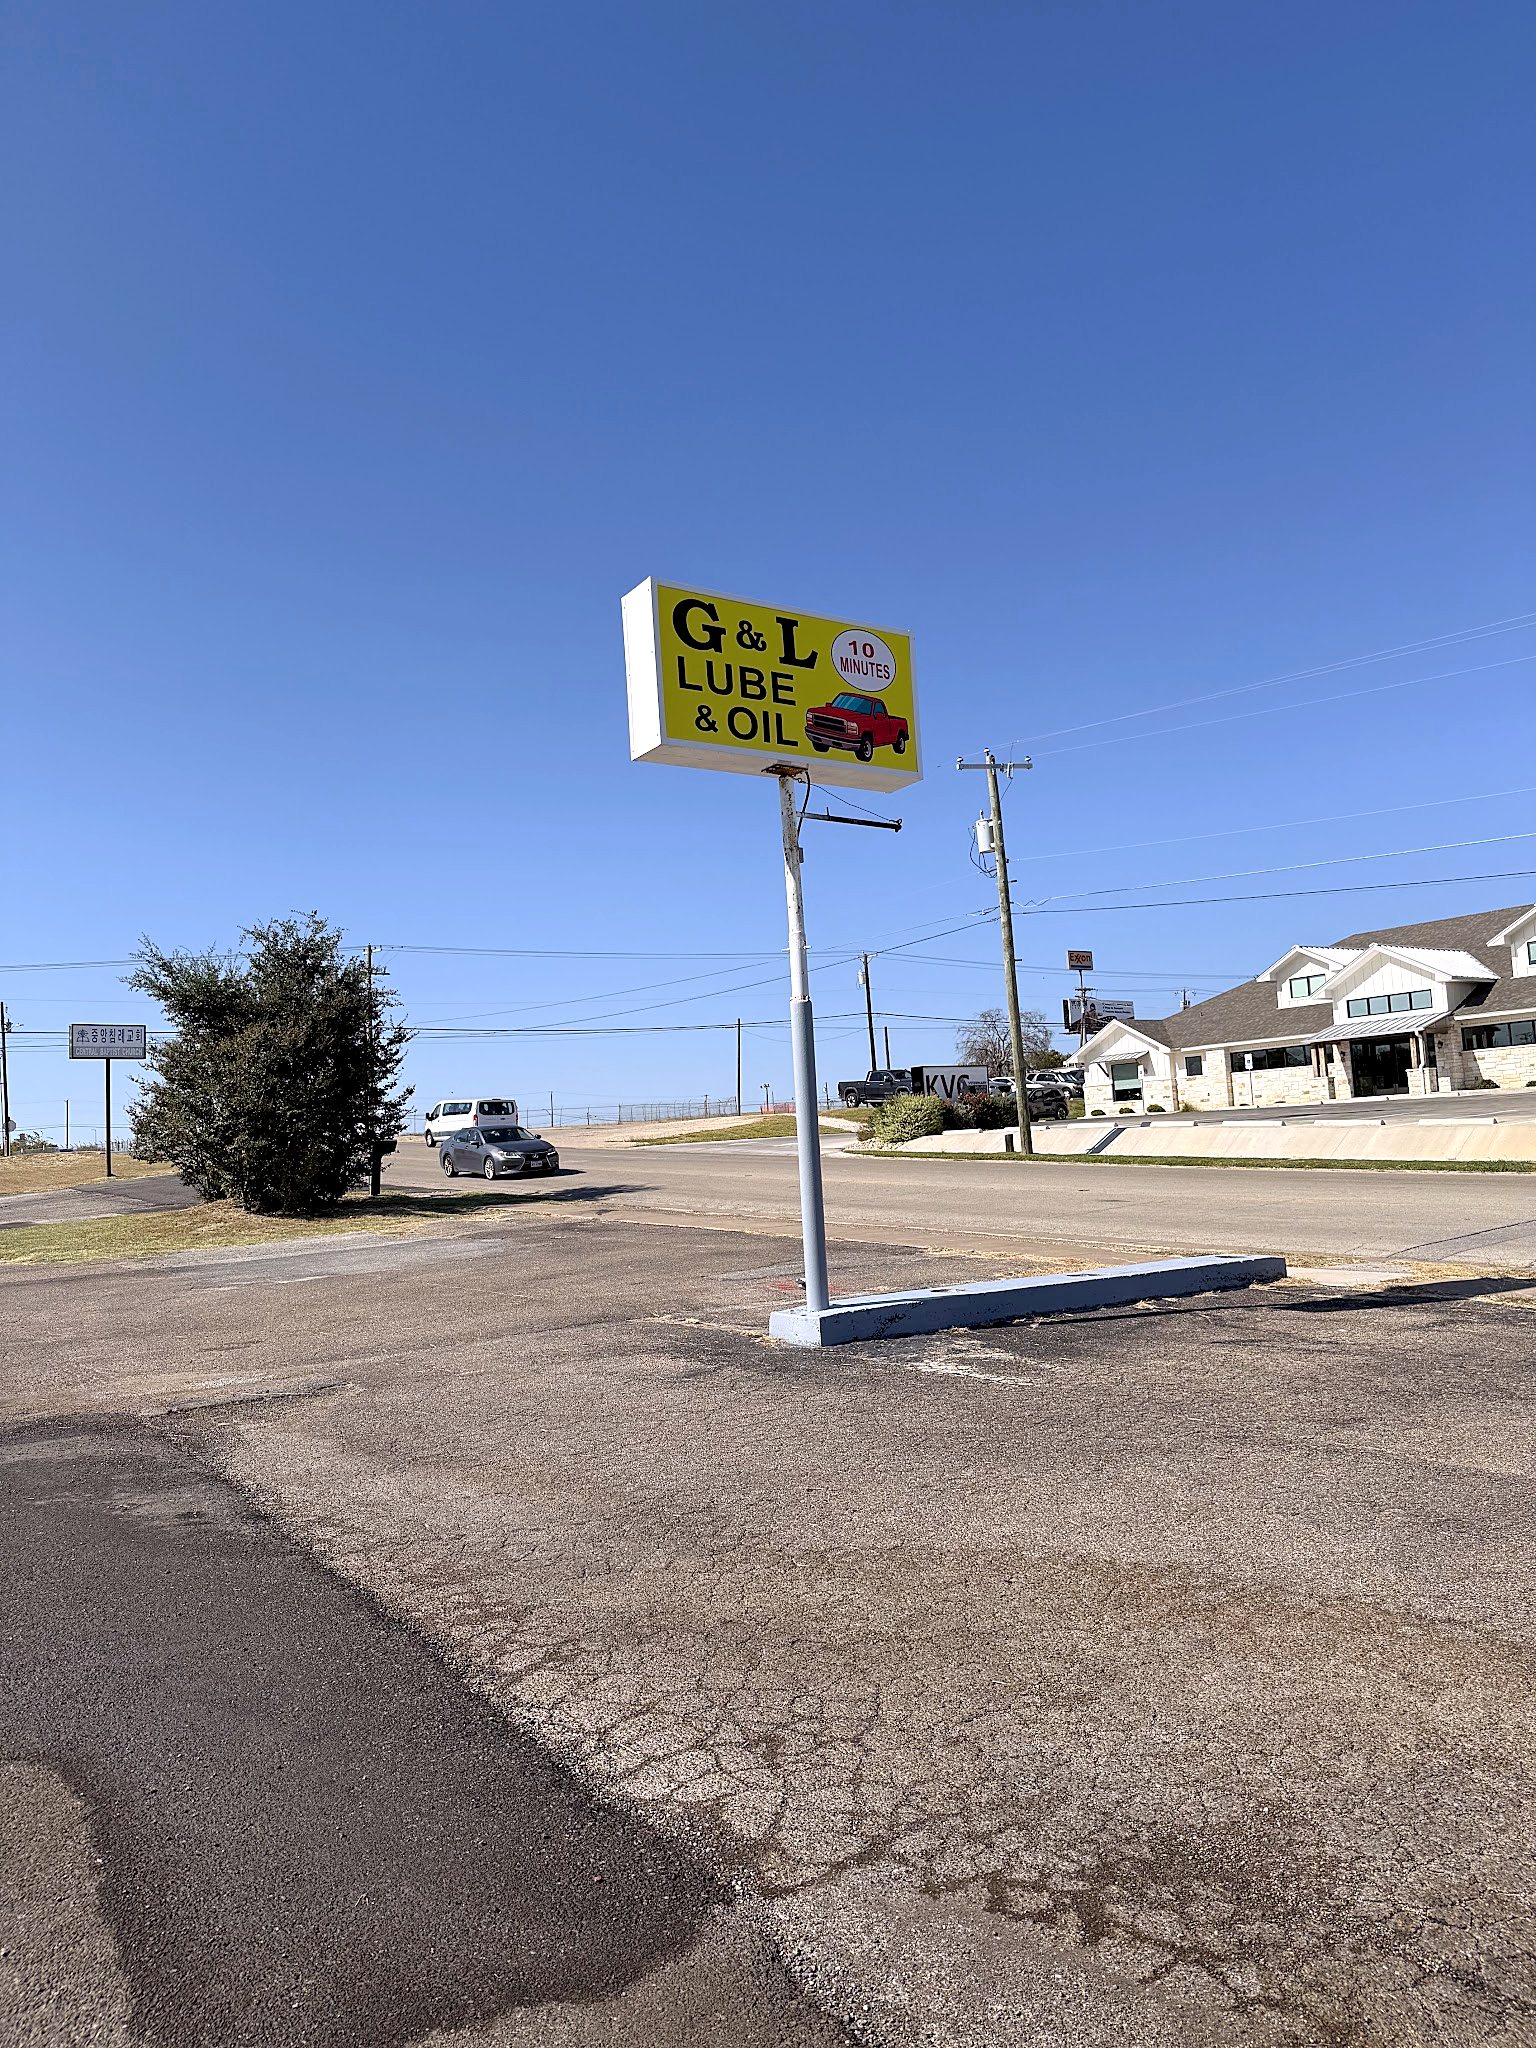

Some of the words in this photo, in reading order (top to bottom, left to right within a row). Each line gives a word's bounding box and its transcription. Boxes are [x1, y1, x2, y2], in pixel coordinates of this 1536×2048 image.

[672, 599, 727, 653] G
[736, 620, 767, 652] &
[775, 616, 818, 670] L
[848, 640, 875, 659] 10
[839, 656, 890, 680] MINUTES
[677, 655, 796, 706] LUBE
[694, 704, 719, 734] &
[727, 706, 799, 747] OIL
[1069, 953, 1091, 964] Exxon
[75, 1048, 99, 1056] CENTRAL
[100, 1048, 120, 1056] BAPTIST
[122, 1048, 143, 1056] CHURCH
